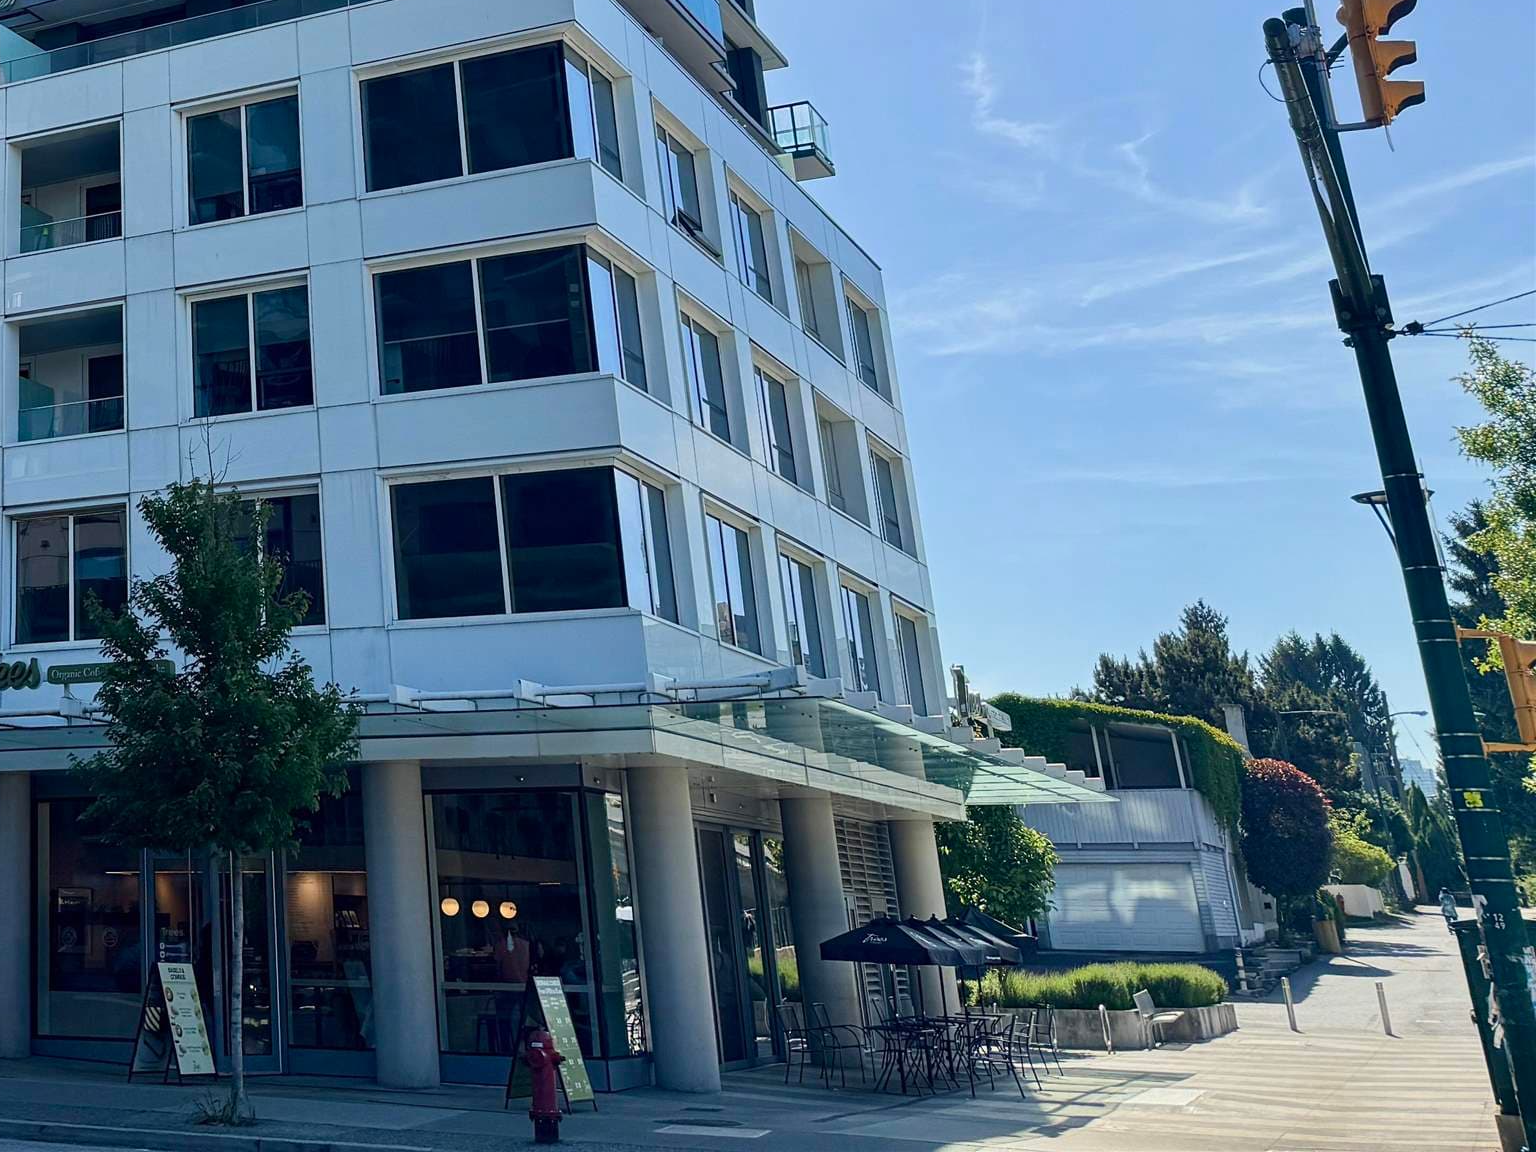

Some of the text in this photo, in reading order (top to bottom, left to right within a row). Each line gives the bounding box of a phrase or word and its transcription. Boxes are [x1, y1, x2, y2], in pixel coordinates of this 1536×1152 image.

[51, 668, 81, 681] Organic
[1493, 913, 1504, 922] 12
[1494, 922, 1506, 930] 49
